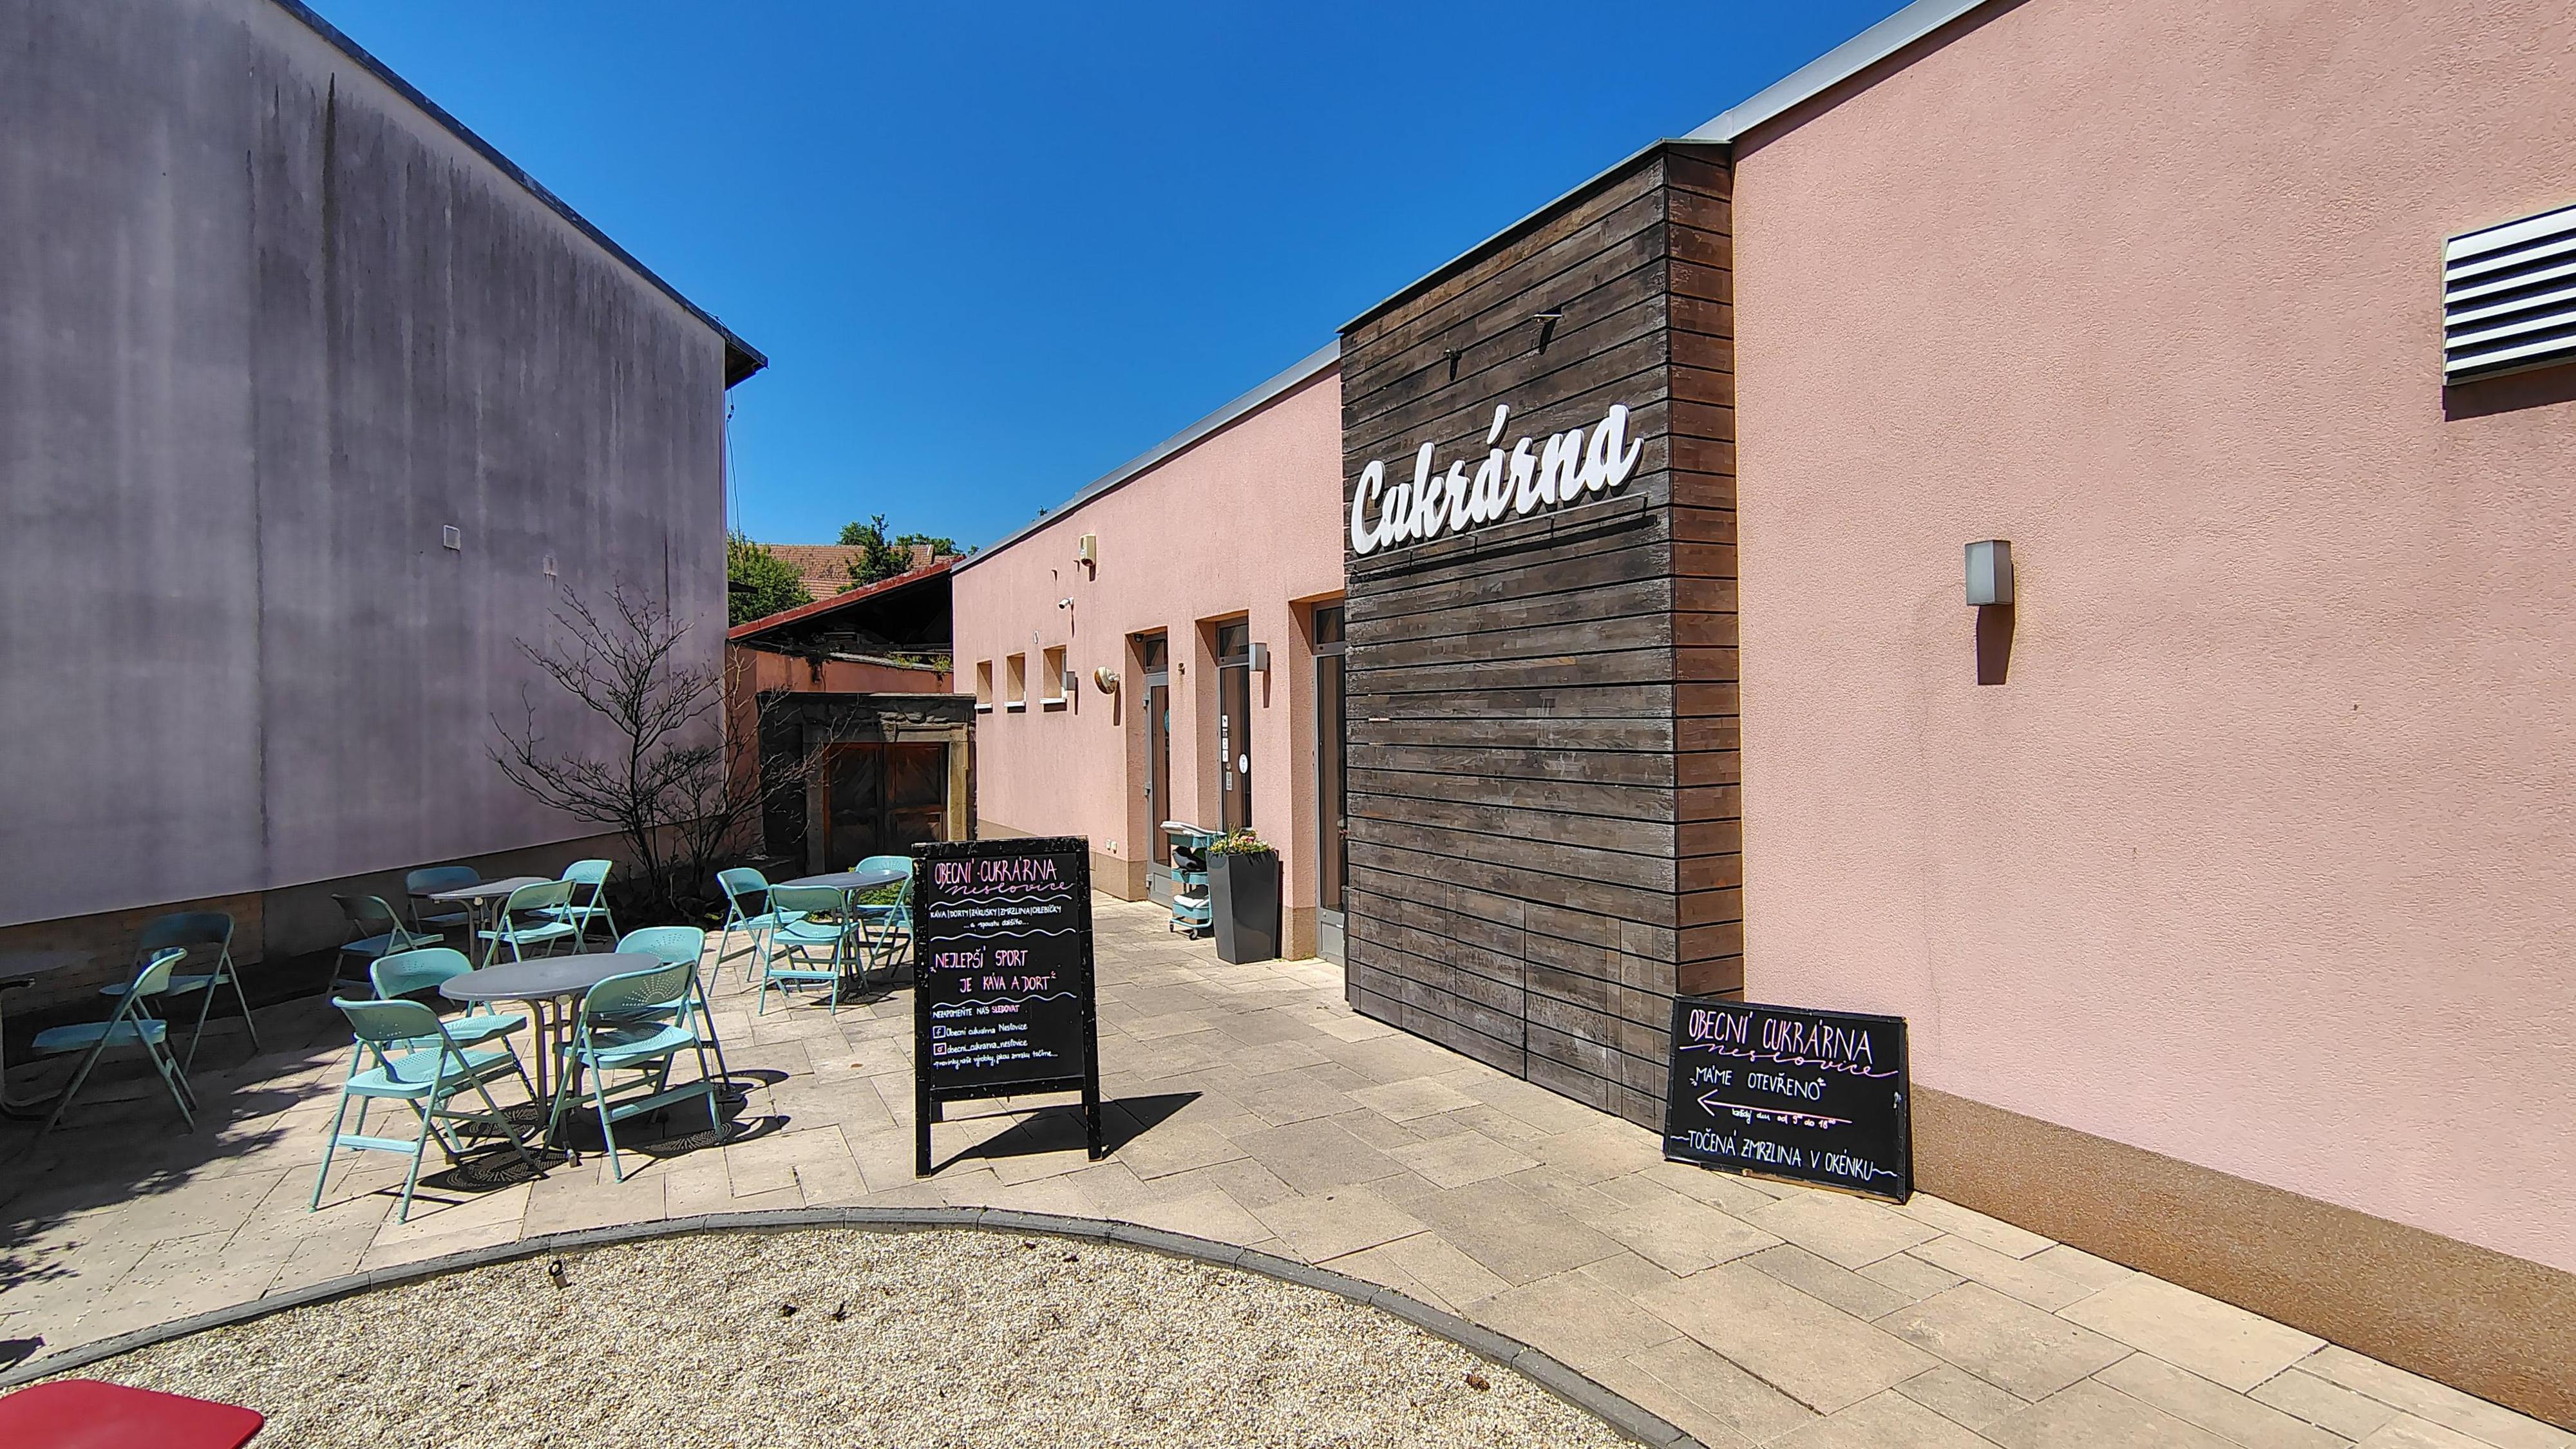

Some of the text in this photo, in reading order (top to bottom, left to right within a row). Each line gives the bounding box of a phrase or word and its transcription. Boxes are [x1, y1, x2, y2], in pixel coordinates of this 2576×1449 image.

[1351, 404, 1644, 555] Cukrárna
[934, 856, 1057, 889] OBECNÍ CUKRÁRNA
[995, 950, 1028, 967] SPORT
[959, 978, 972, 993] JE
[983, 972, 1006, 990] KÁVA
[1011, 976, 1019, 990] A
[1689, 1009, 1873, 1065] OBECNÍ CUKRÁRNA
[1777, 1114, 1788, 1124] od
[1687, 1128, 1874, 1181] TOČENÁ ZMRZLINA V OKÉNKU
